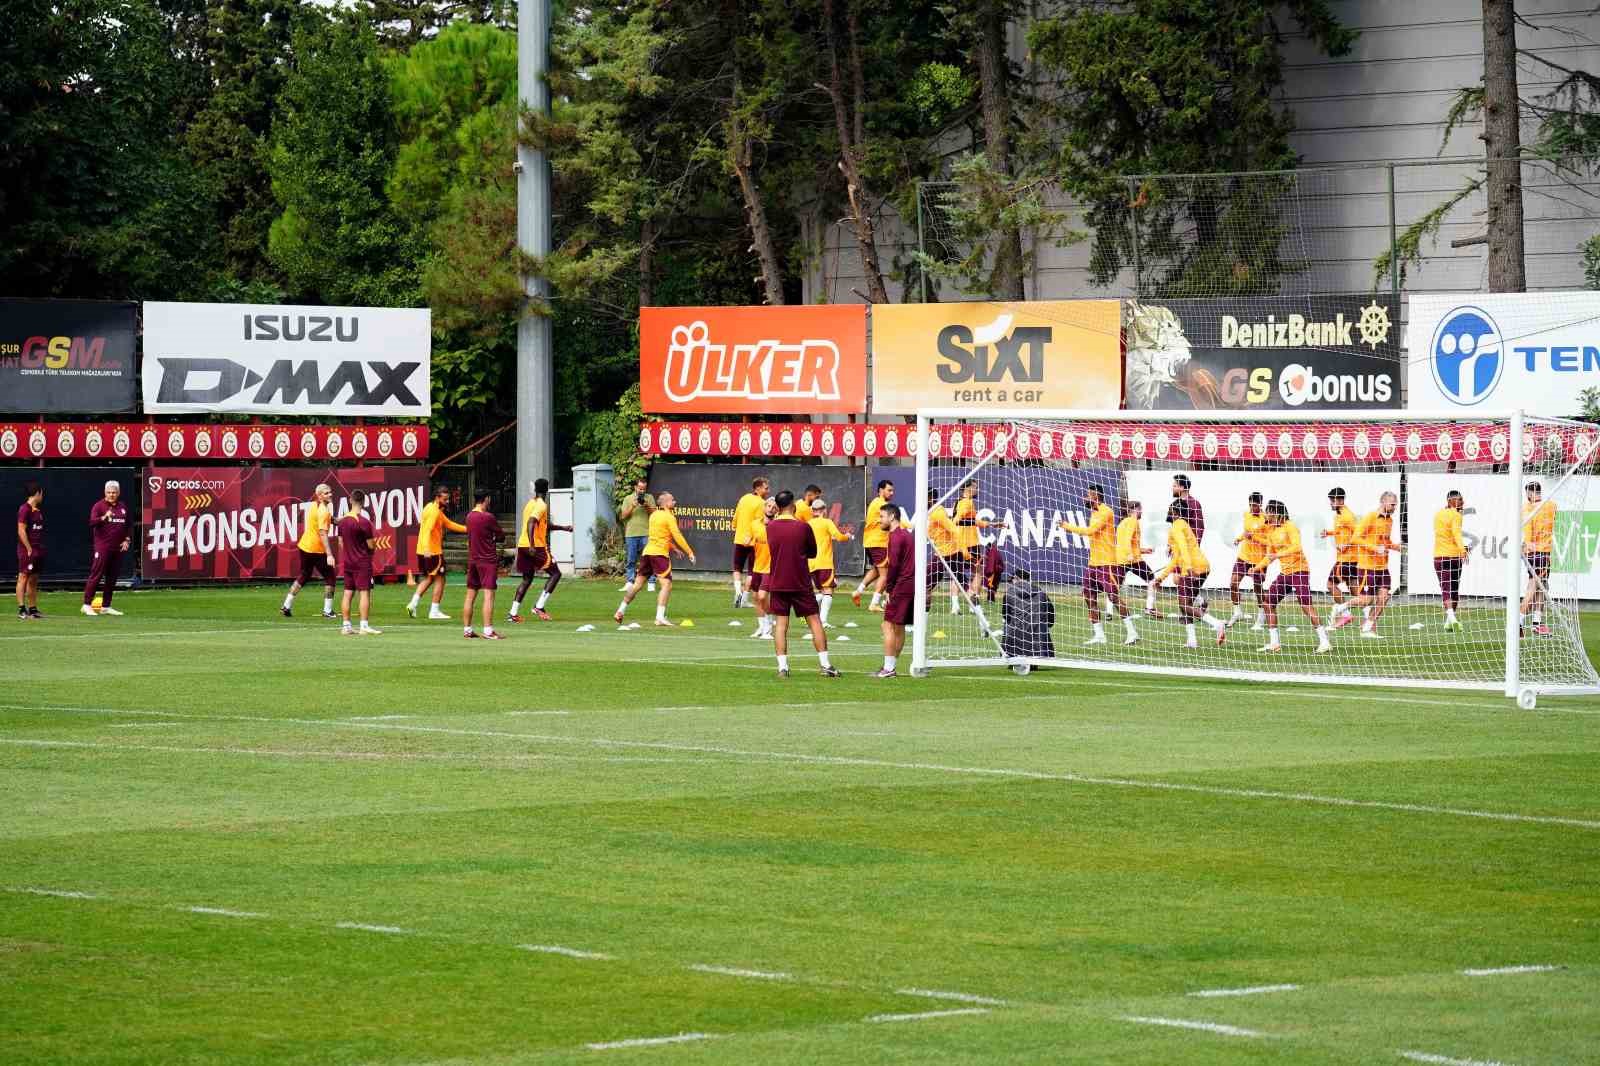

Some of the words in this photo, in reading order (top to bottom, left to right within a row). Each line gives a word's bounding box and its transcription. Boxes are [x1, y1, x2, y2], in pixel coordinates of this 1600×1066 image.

[244, 314, 359, 342] ISUZU
[1221, 312, 1353, 348] DenizBank
[664, 320, 841, 403] ÜLKER
[156, 357, 422, 407] D-MAX
[953, 387, 992, 402] rent
[997, 389, 1008, 402] a
[1013, 389, 1044, 402] car
[1220, 367, 1273, 404] GS
[1306, 366, 1392, 402] bonus
[695, 519, 712, 530] TEK
[713, 517, 737, 532] YÜRE
